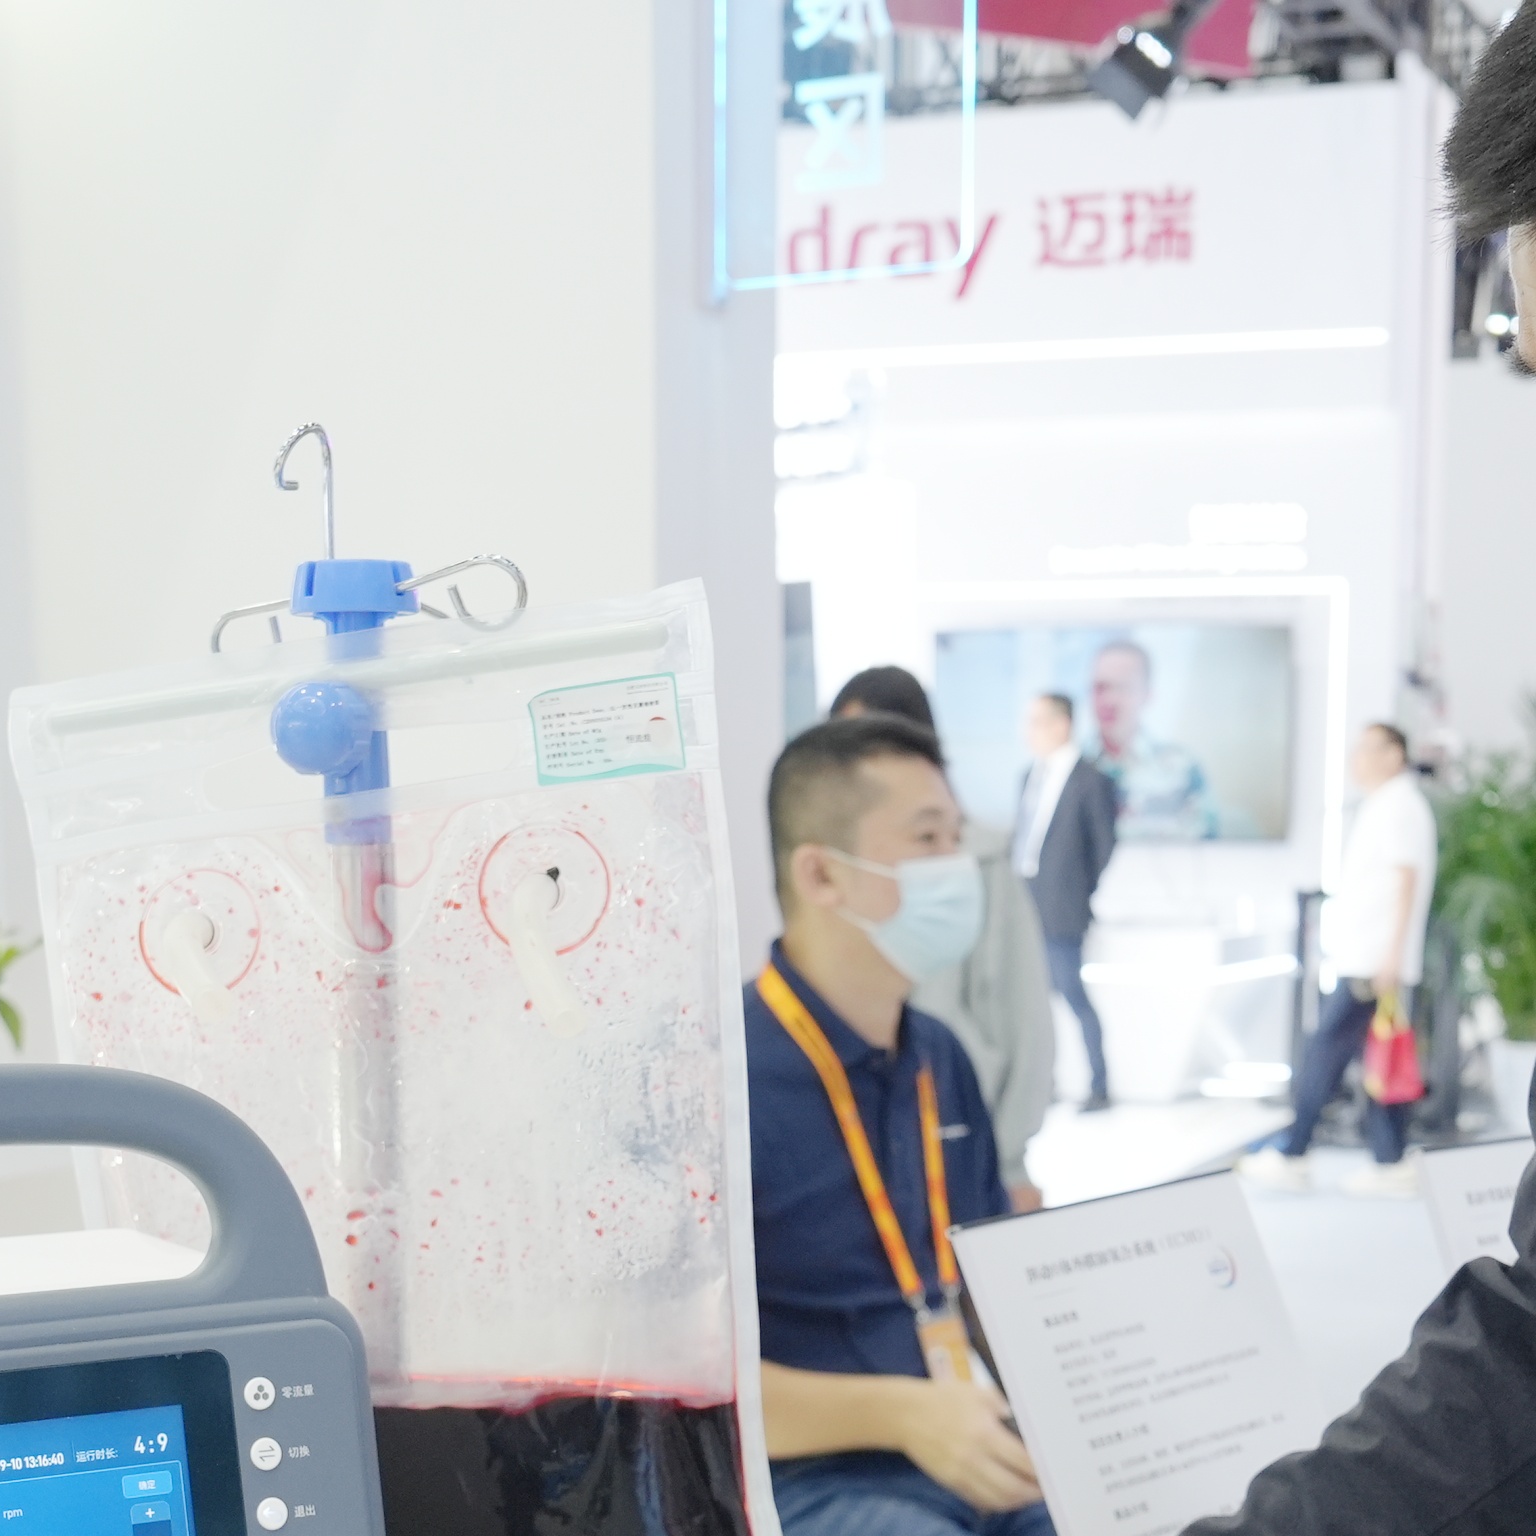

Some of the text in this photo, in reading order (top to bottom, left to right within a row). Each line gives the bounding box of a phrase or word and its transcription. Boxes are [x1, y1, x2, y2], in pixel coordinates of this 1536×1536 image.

[1038, 188, 1195, 268] 迈瑞
[281, 1384, 314, 1399] 零流量
[134, 1432, 168, 1455] 4:9
[288, 1446, 310, 1458] 切换
[24, 1452, 64, 1470] 13:16:40
[3, 1508, 23, 1520] rpm
[294, 1505, 316, 1518] 退出
